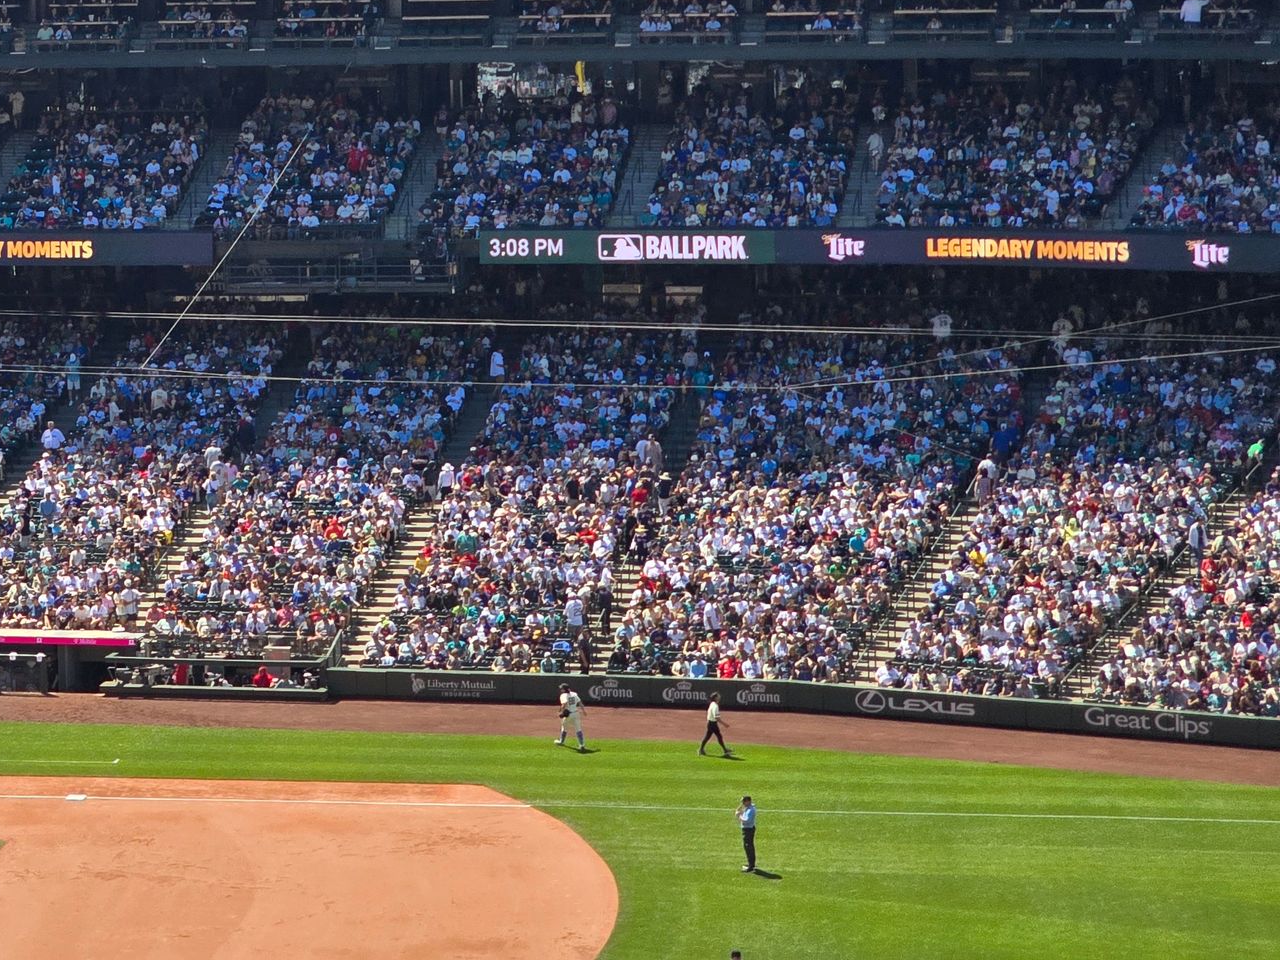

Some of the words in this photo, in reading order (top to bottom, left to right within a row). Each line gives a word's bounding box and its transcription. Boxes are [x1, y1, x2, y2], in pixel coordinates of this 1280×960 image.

[7, 240, 93, 259] MOMENTS
[489, 238, 529, 257] 3:08
[535, 239, 563, 257] PM
[646, 235, 746, 260] BALLPARK
[828, 237, 865, 261] Lite
[926, 238, 1034, 259] LEGENDARY
[1037, 240, 1130, 262] MOMENTS
[1192, 243, 1230, 268] Lite
[427, 679, 458, 691] Liberty
[588, 685, 633, 700] Corona
[662, 687, 707, 703] Corona
[736, 690, 781, 705] Corona
[888, 696, 975, 716] LEXUS
[1084, 707, 1151, 730] Great
[1155, 712, 1210, 739] Clips
